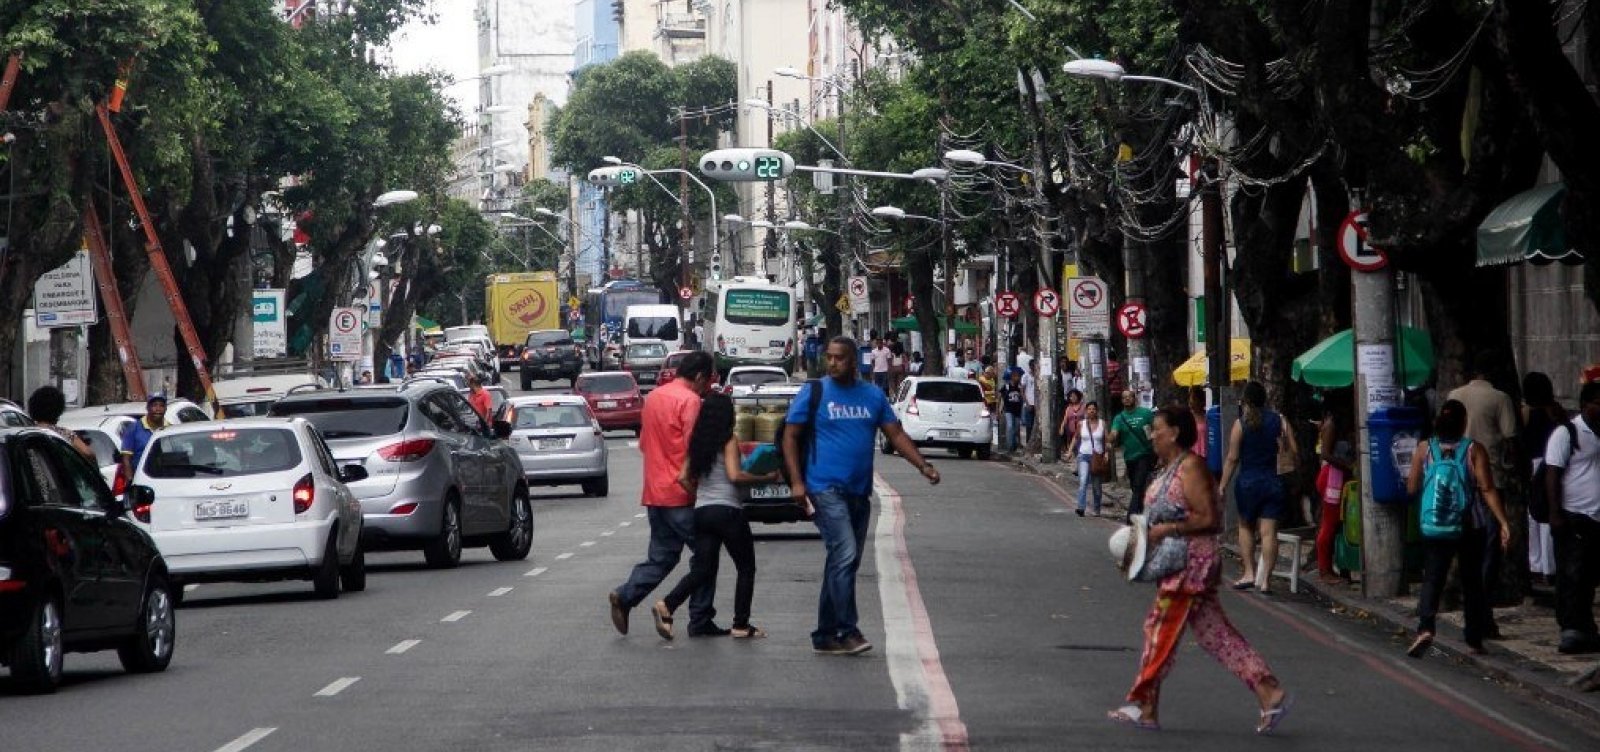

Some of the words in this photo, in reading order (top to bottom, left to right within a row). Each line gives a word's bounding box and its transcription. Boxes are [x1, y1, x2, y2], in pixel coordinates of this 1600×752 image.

[757, 157, 781, 178] 22
[508, 294, 540, 317] SKOL
[341, 315, 351, 328] E
